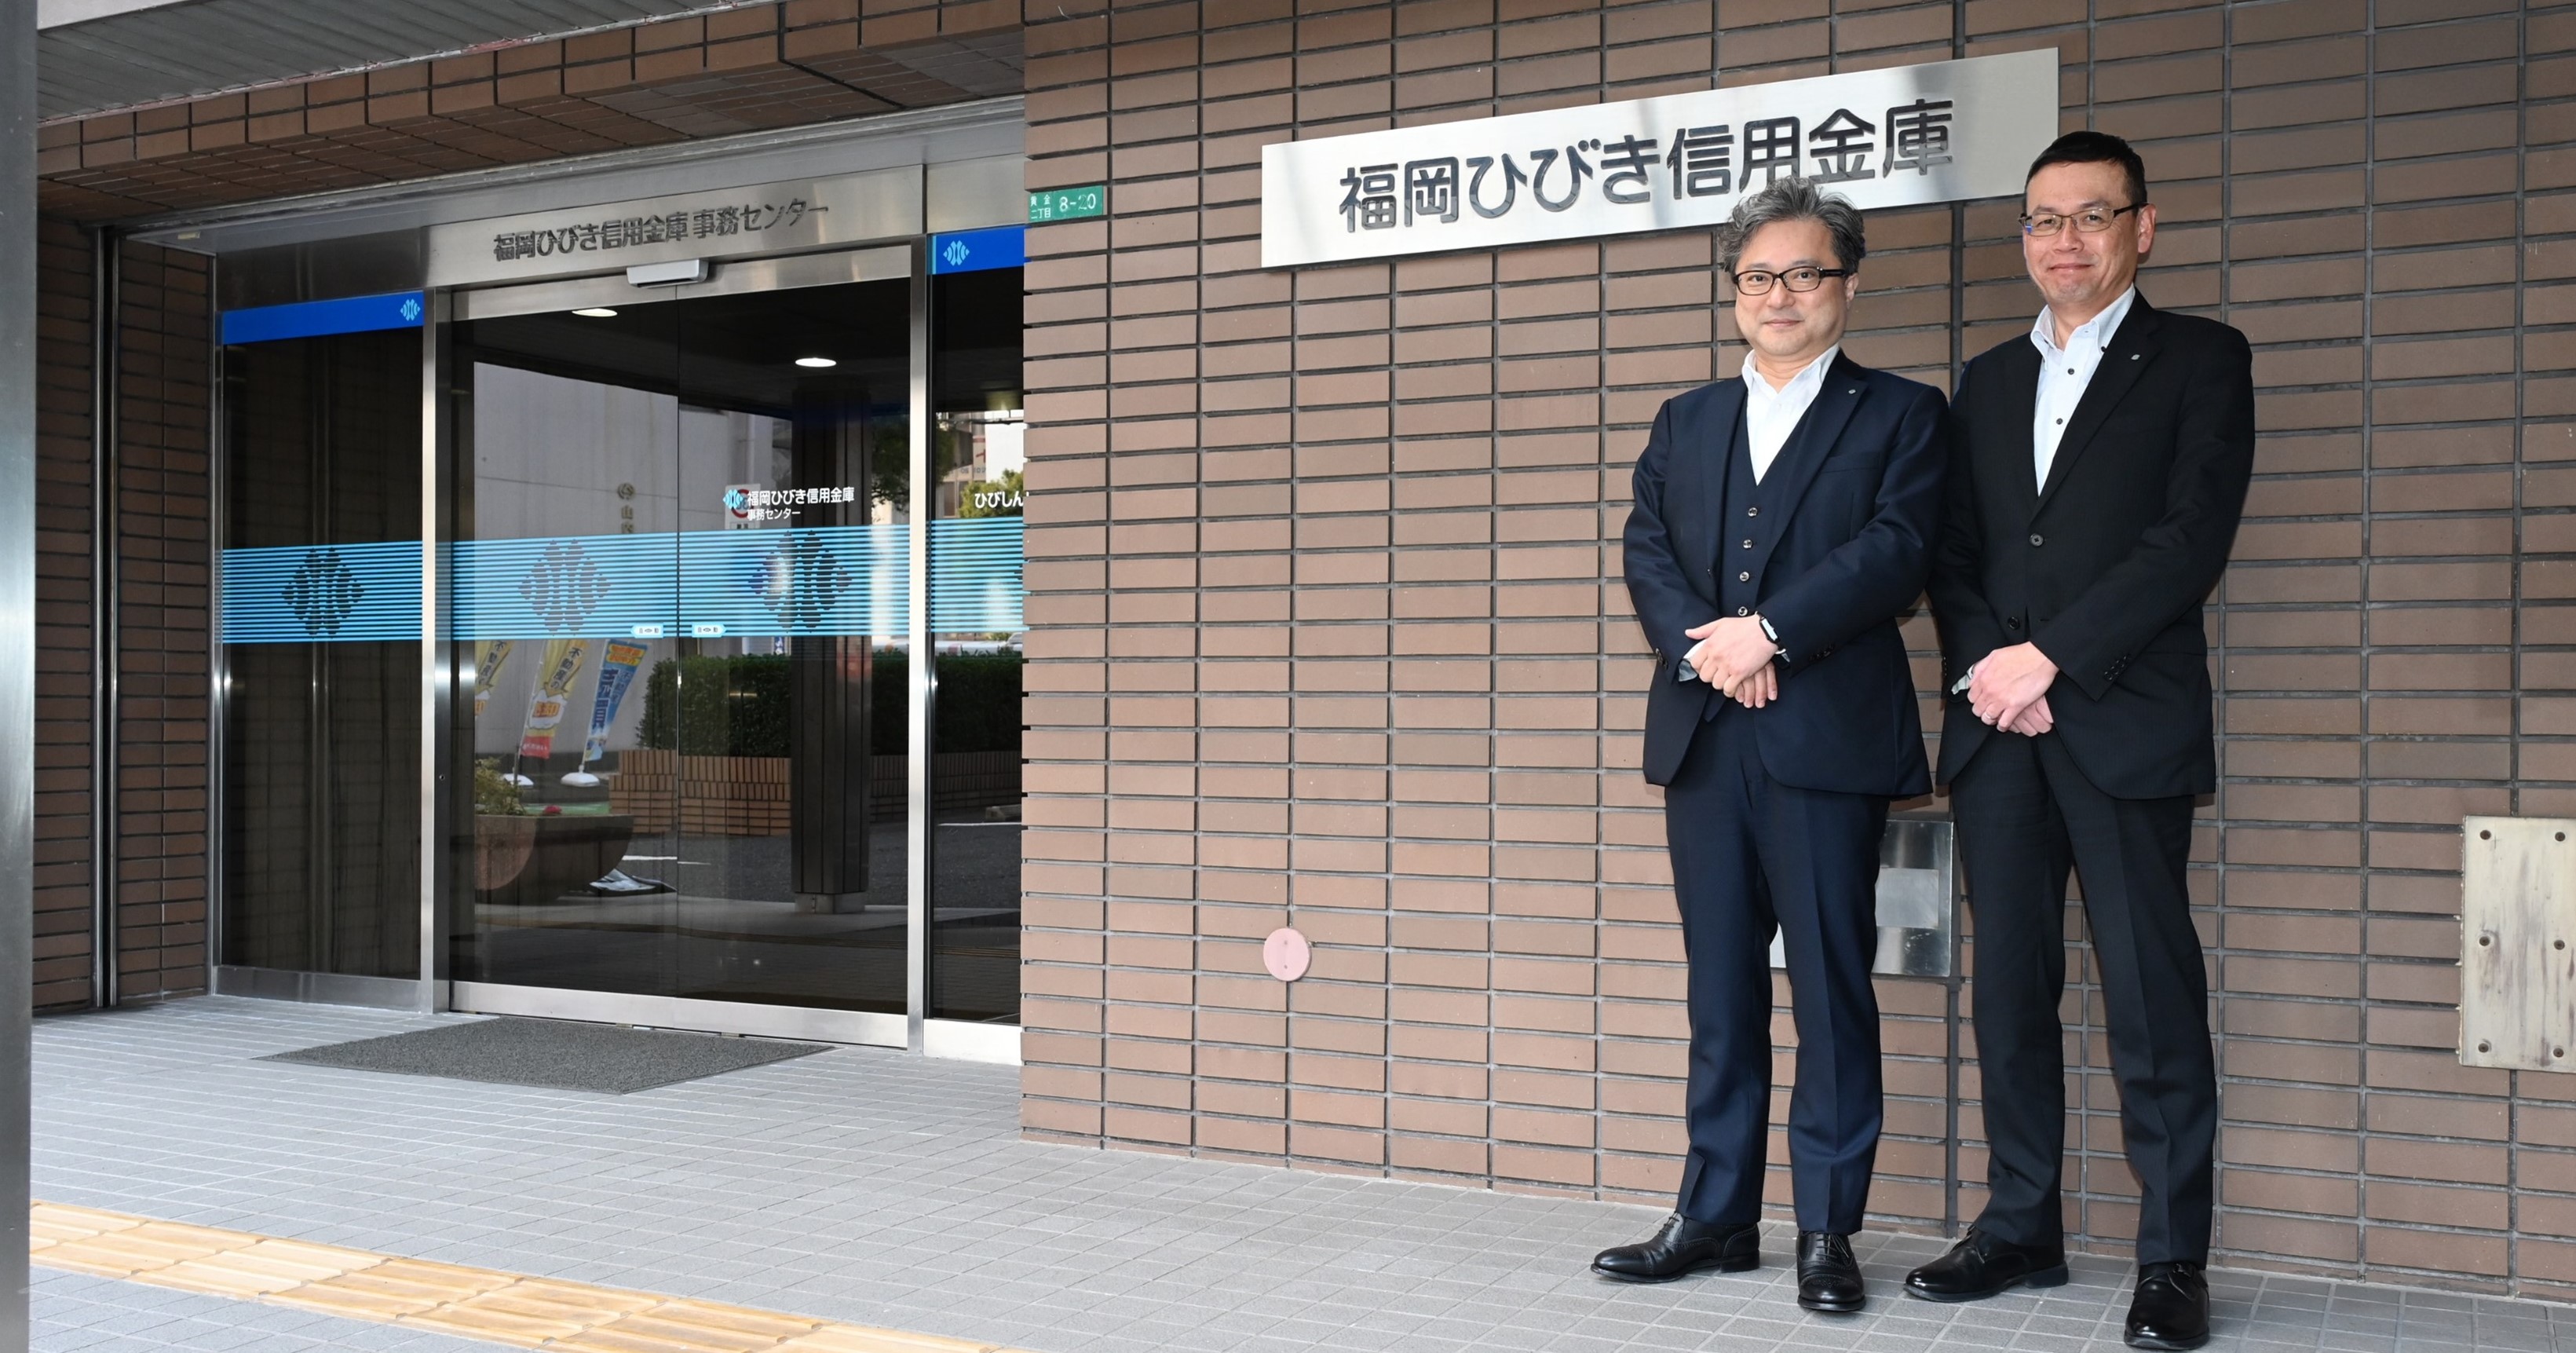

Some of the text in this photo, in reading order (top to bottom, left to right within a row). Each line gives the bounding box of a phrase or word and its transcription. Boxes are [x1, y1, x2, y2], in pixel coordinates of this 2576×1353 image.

[1339, 98, 1953, 233] 福岡ひびき信用金庫
[1031, 207, 1051, 219] 二丁目
[494, 198, 829, 261] 福岡ひびき信用金庫 事務センター
[747, 486, 855, 506] 福岡ひびき信用金庫
[974, 490, 1030, 509] ひびしん
[747, 508, 801, 521] 事務センター
